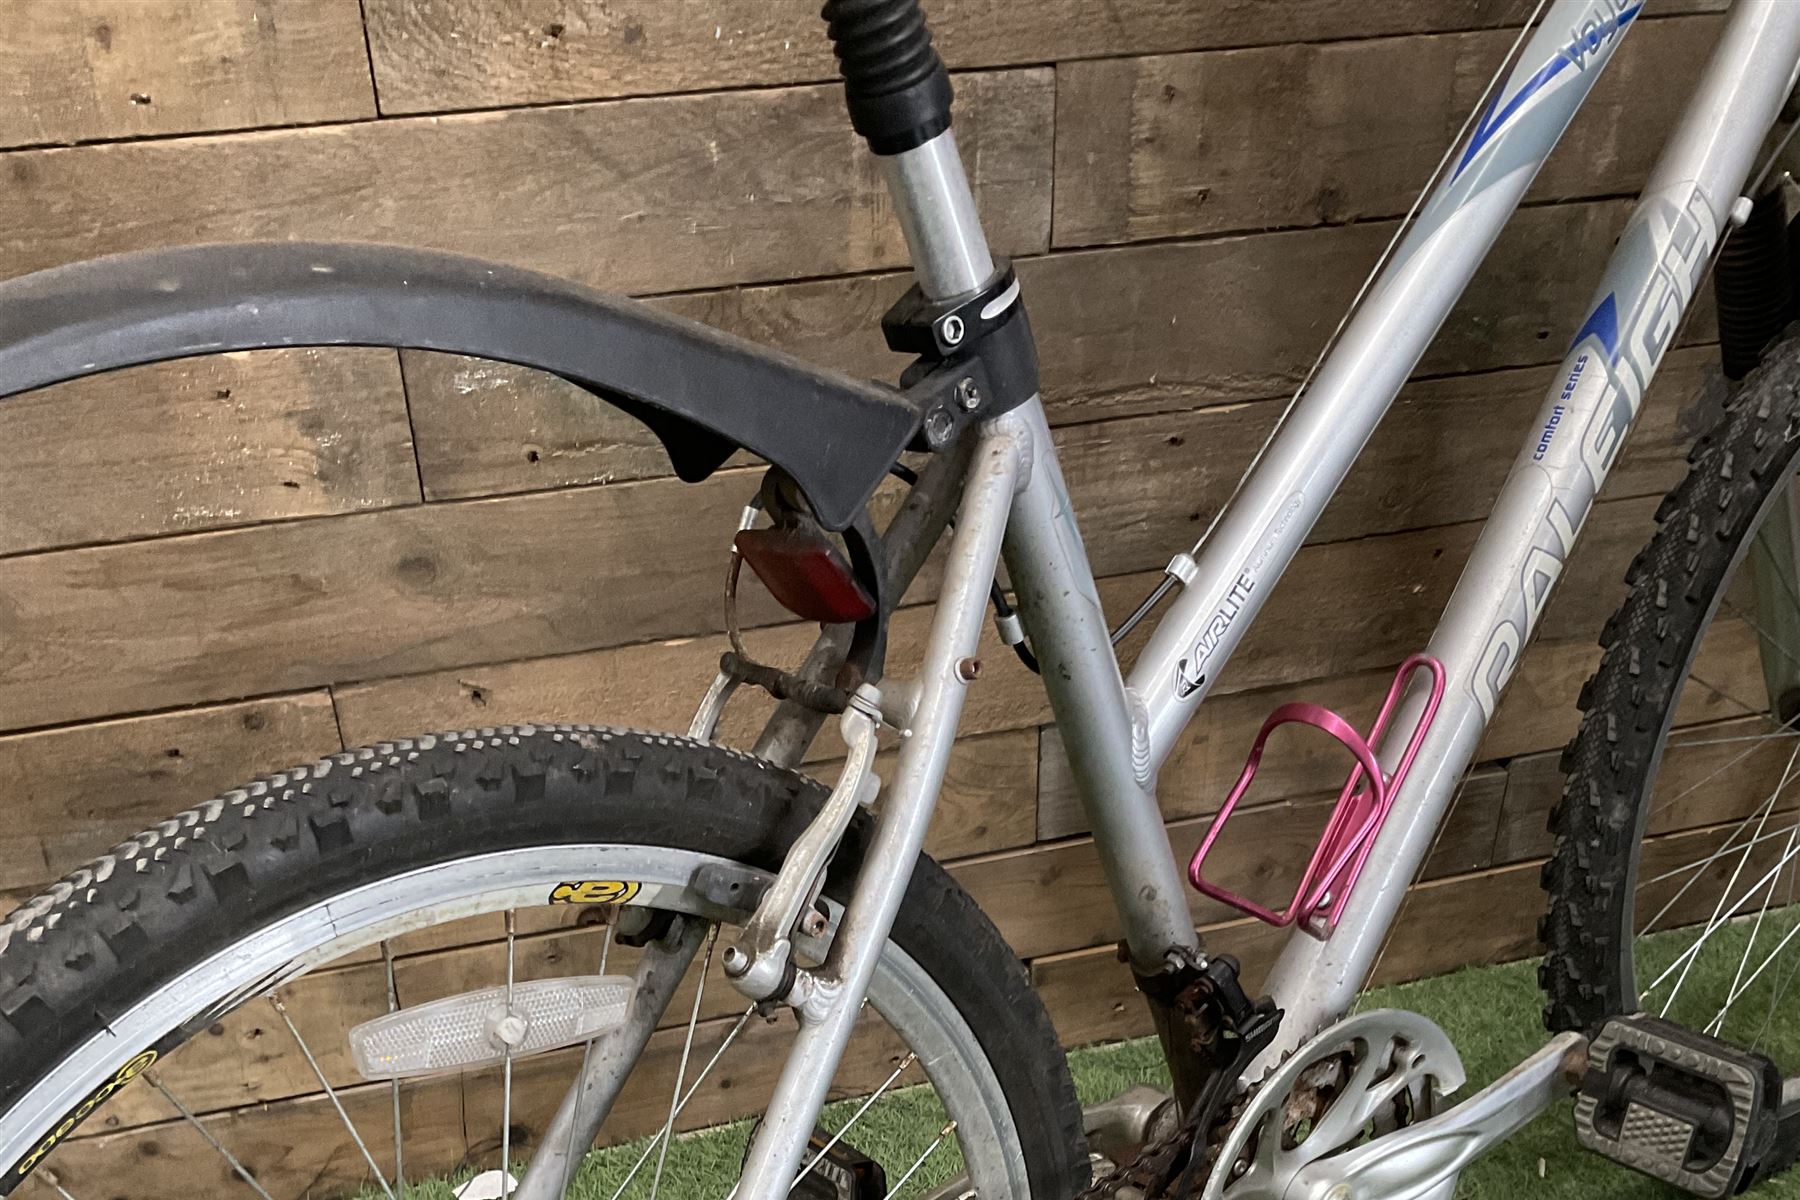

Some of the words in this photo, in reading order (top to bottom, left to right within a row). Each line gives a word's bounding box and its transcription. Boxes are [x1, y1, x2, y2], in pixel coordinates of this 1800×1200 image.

[1471, 182, 1717, 727] RALEIGH
[1533, 405, 1565, 461] comfort
[1561, 355, 1588, 400] series
